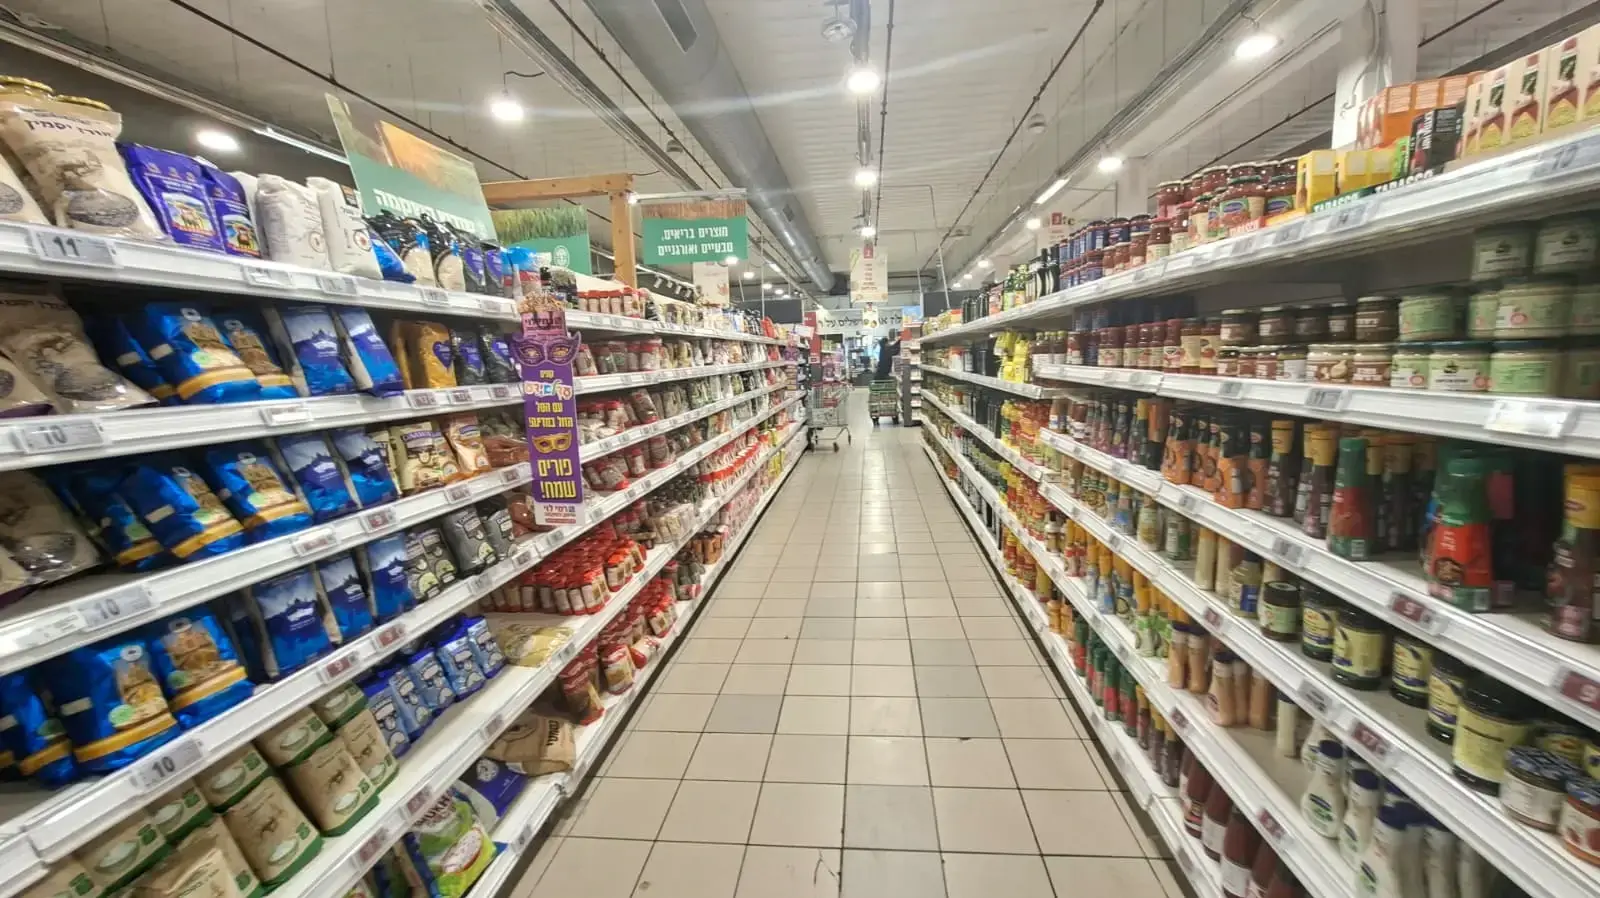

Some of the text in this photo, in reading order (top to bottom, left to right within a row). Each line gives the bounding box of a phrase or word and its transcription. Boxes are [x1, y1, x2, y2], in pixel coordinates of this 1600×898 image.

[661, 226, 728, 242] מוצרים בריאים,
[657, 242, 734, 256] טבעיים ואורגניים
[538, 458, 573, 477] פורים
[540, 480, 577, 499] שמח!
[152, 756, 176, 778] 10
